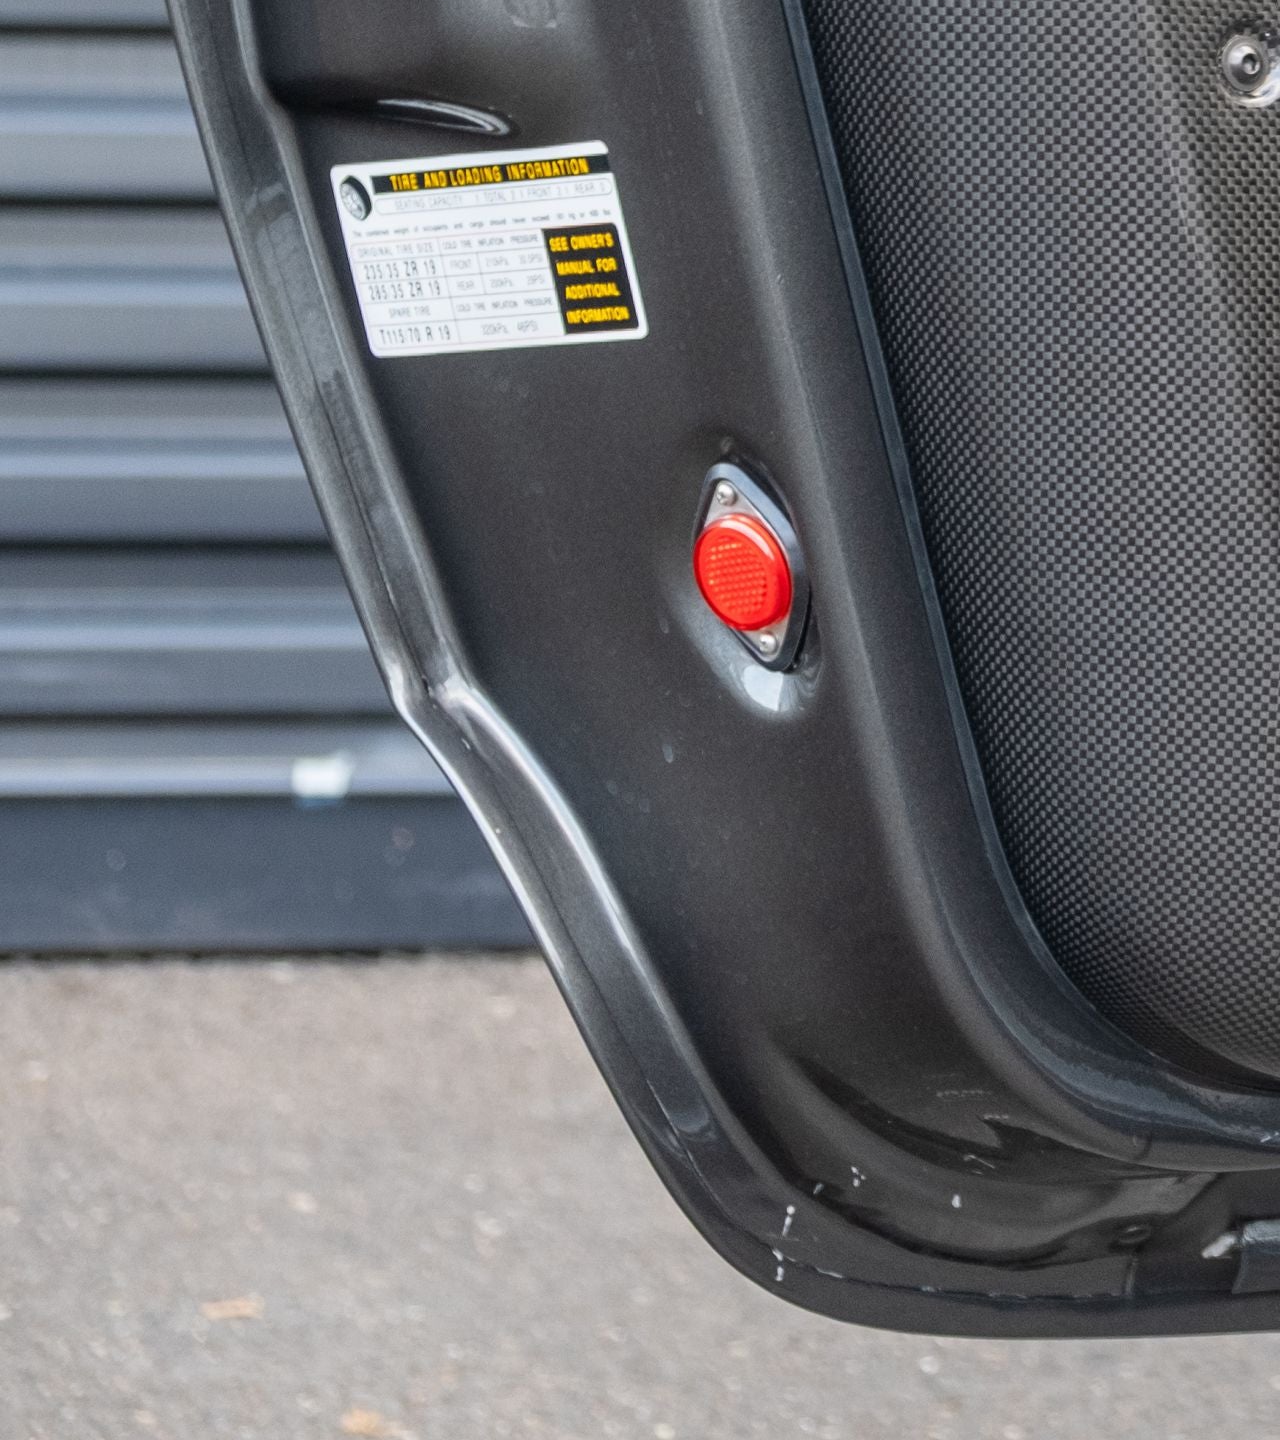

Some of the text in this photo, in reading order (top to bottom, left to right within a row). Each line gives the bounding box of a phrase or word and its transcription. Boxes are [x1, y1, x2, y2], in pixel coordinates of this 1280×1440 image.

[390, 158, 589, 192] TIRE AND LOADING INFORMATION
[549, 232, 614, 252] SEE OWNER'S
[556, 257, 617, 276] MANUAL FOR
[565, 282, 621, 299] ADDITIONAL
[566, 306, 630, 324] INFORMATION
